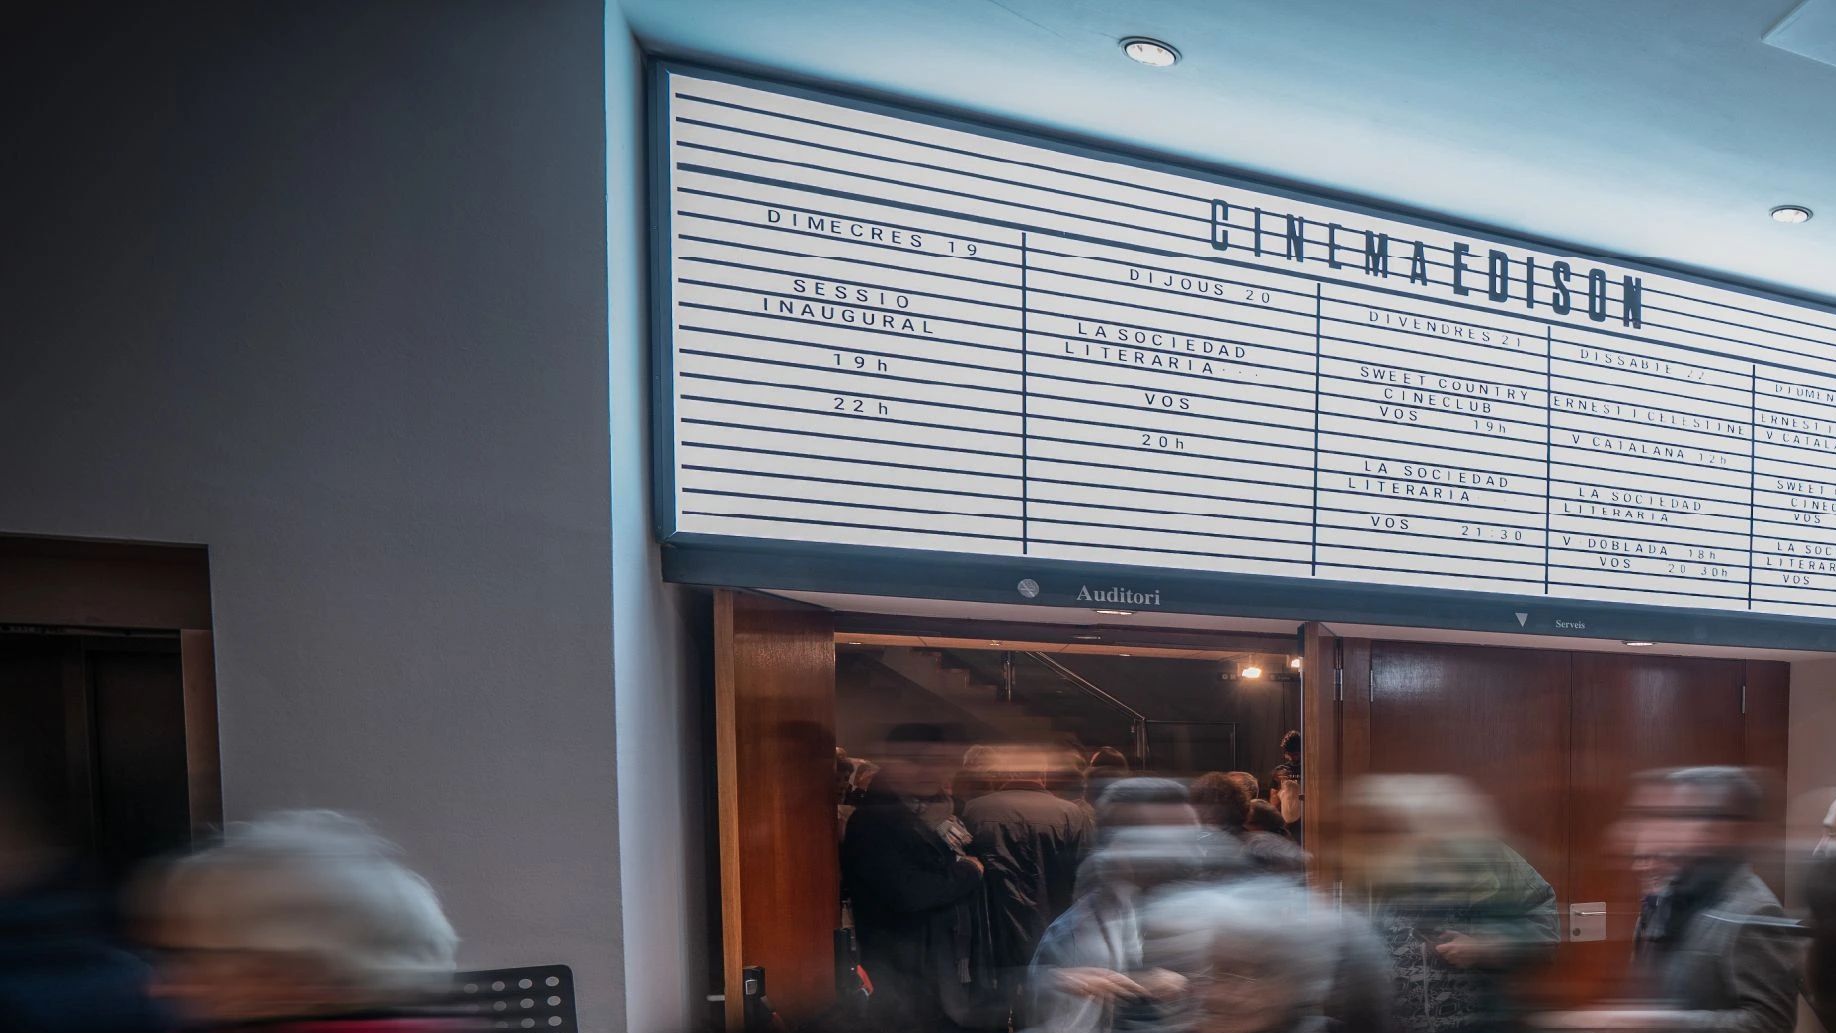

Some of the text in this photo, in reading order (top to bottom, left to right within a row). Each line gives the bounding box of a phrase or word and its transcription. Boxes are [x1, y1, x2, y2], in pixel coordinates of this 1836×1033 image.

[767, 209, 977, 256] DIMECRES 19
[793, 279, 909, 308] SESSIO
[1130, 268, 1270, 303] DIJOUS 20
[763, 298, 933, 334] INAUGURAL
[1369, 311, 1521, 347] DIVENDRES 21
[1580, 348, 1672, 374] DISSABTE
[1360, 366, 1528, 401] SWEET COUNTRY
[1144, 392, 1190, 410] VOS
[1384, 388, 1491, 413] CINECLUB
[1553, 395, 1621, 416] ERNEST
[1379, 405, 1506, 433] VOS 19h
[1142, 433, 1184, 450] 20h
[1592, 436, 1685, 459] CATALANA
[1364, 460, 1508, 488] LA SOCIEDAD
[1579, 487, 1702, 511] LA SOCIEDAD
[1777, 480, 1825, 495] SWEET
[1370, 515, 1409, 530] VOS
[1564, 503, 1669, 522] LITERARIA
[1793, 513, 1821, 524] VOS
[1588, 537, 1668, 556] DOBLADA
[1688, 548, 1716, 560] 18h
[1777, 541, 1795, 553] LA
[1599, 556, 1631, 569] VOS
[1783, 574, 1810, 585] VOS
[1076, 584, 1161, 605] Auditori
[1555, 619, 1586, 629] Serveis
